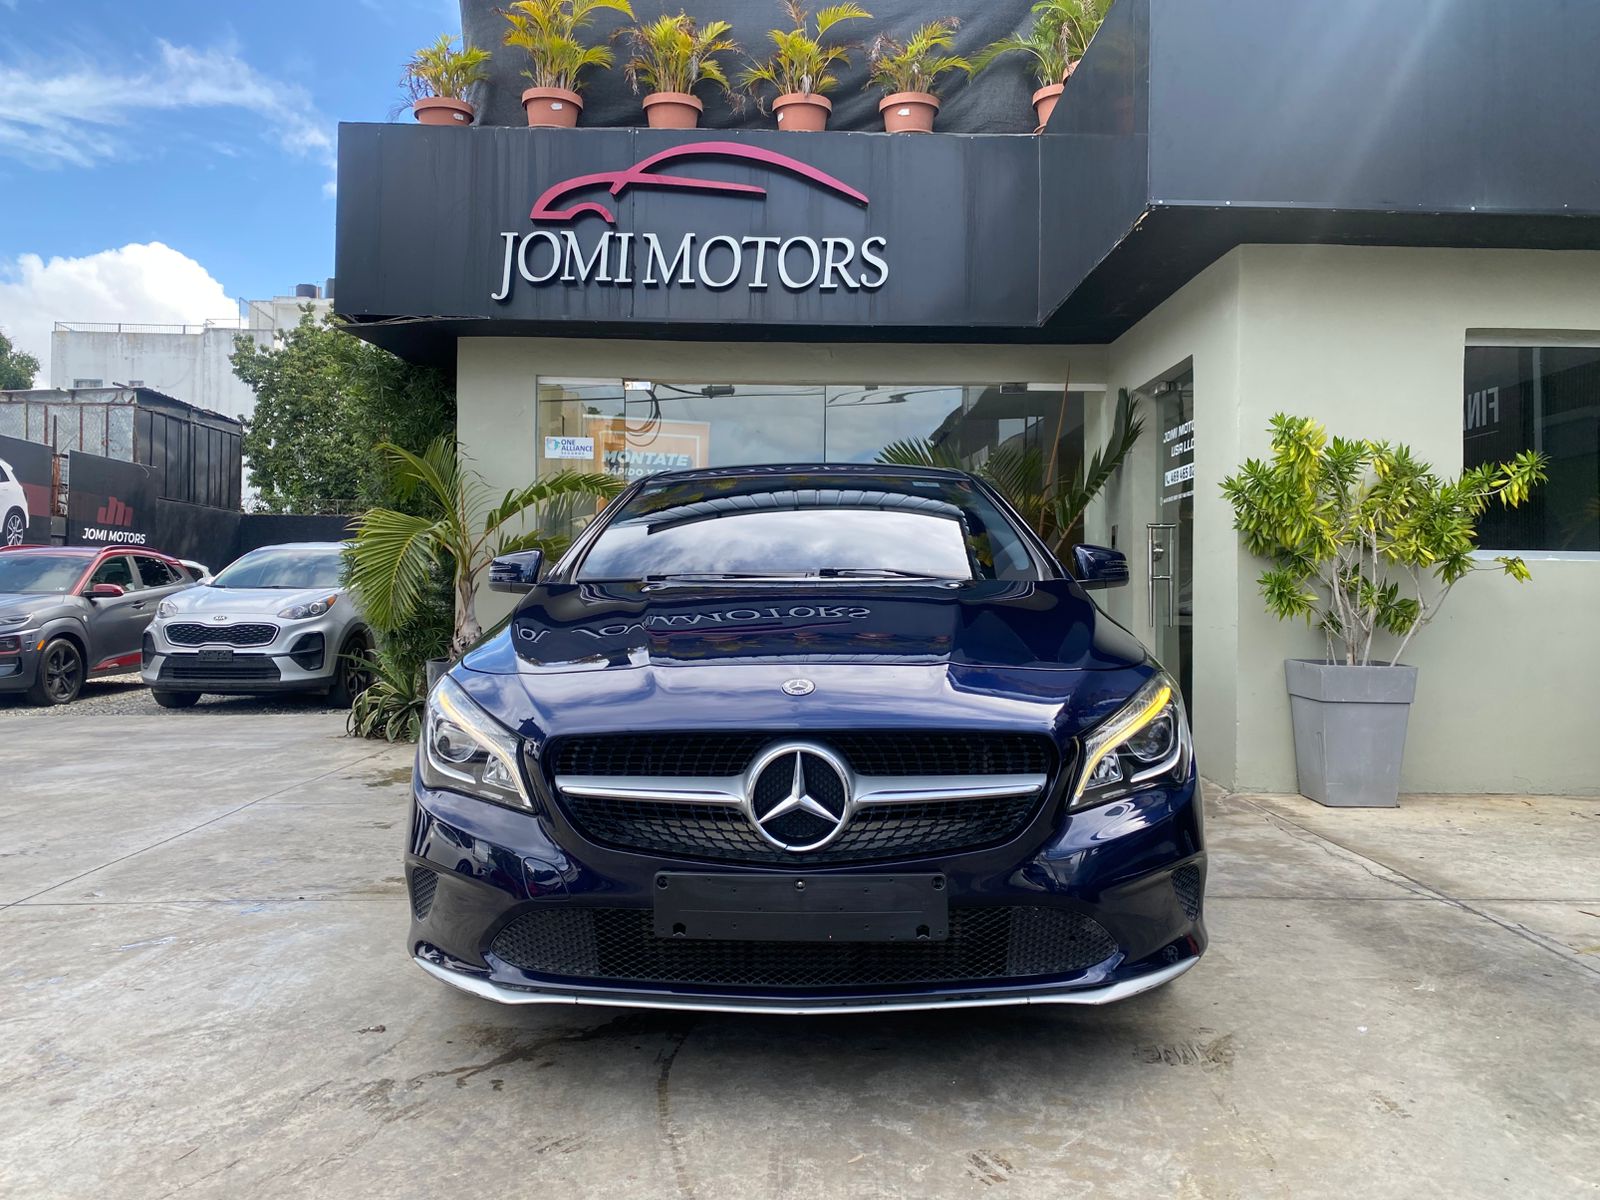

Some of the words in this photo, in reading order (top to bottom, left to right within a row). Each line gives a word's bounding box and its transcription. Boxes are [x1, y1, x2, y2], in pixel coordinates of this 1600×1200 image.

[491, 230, 634, 300] JOMI
[642, 232, 889, 289] MOTORS
[82, 527, 107, 541] JOMI
[108, 530, 146, 544] MOTORS
